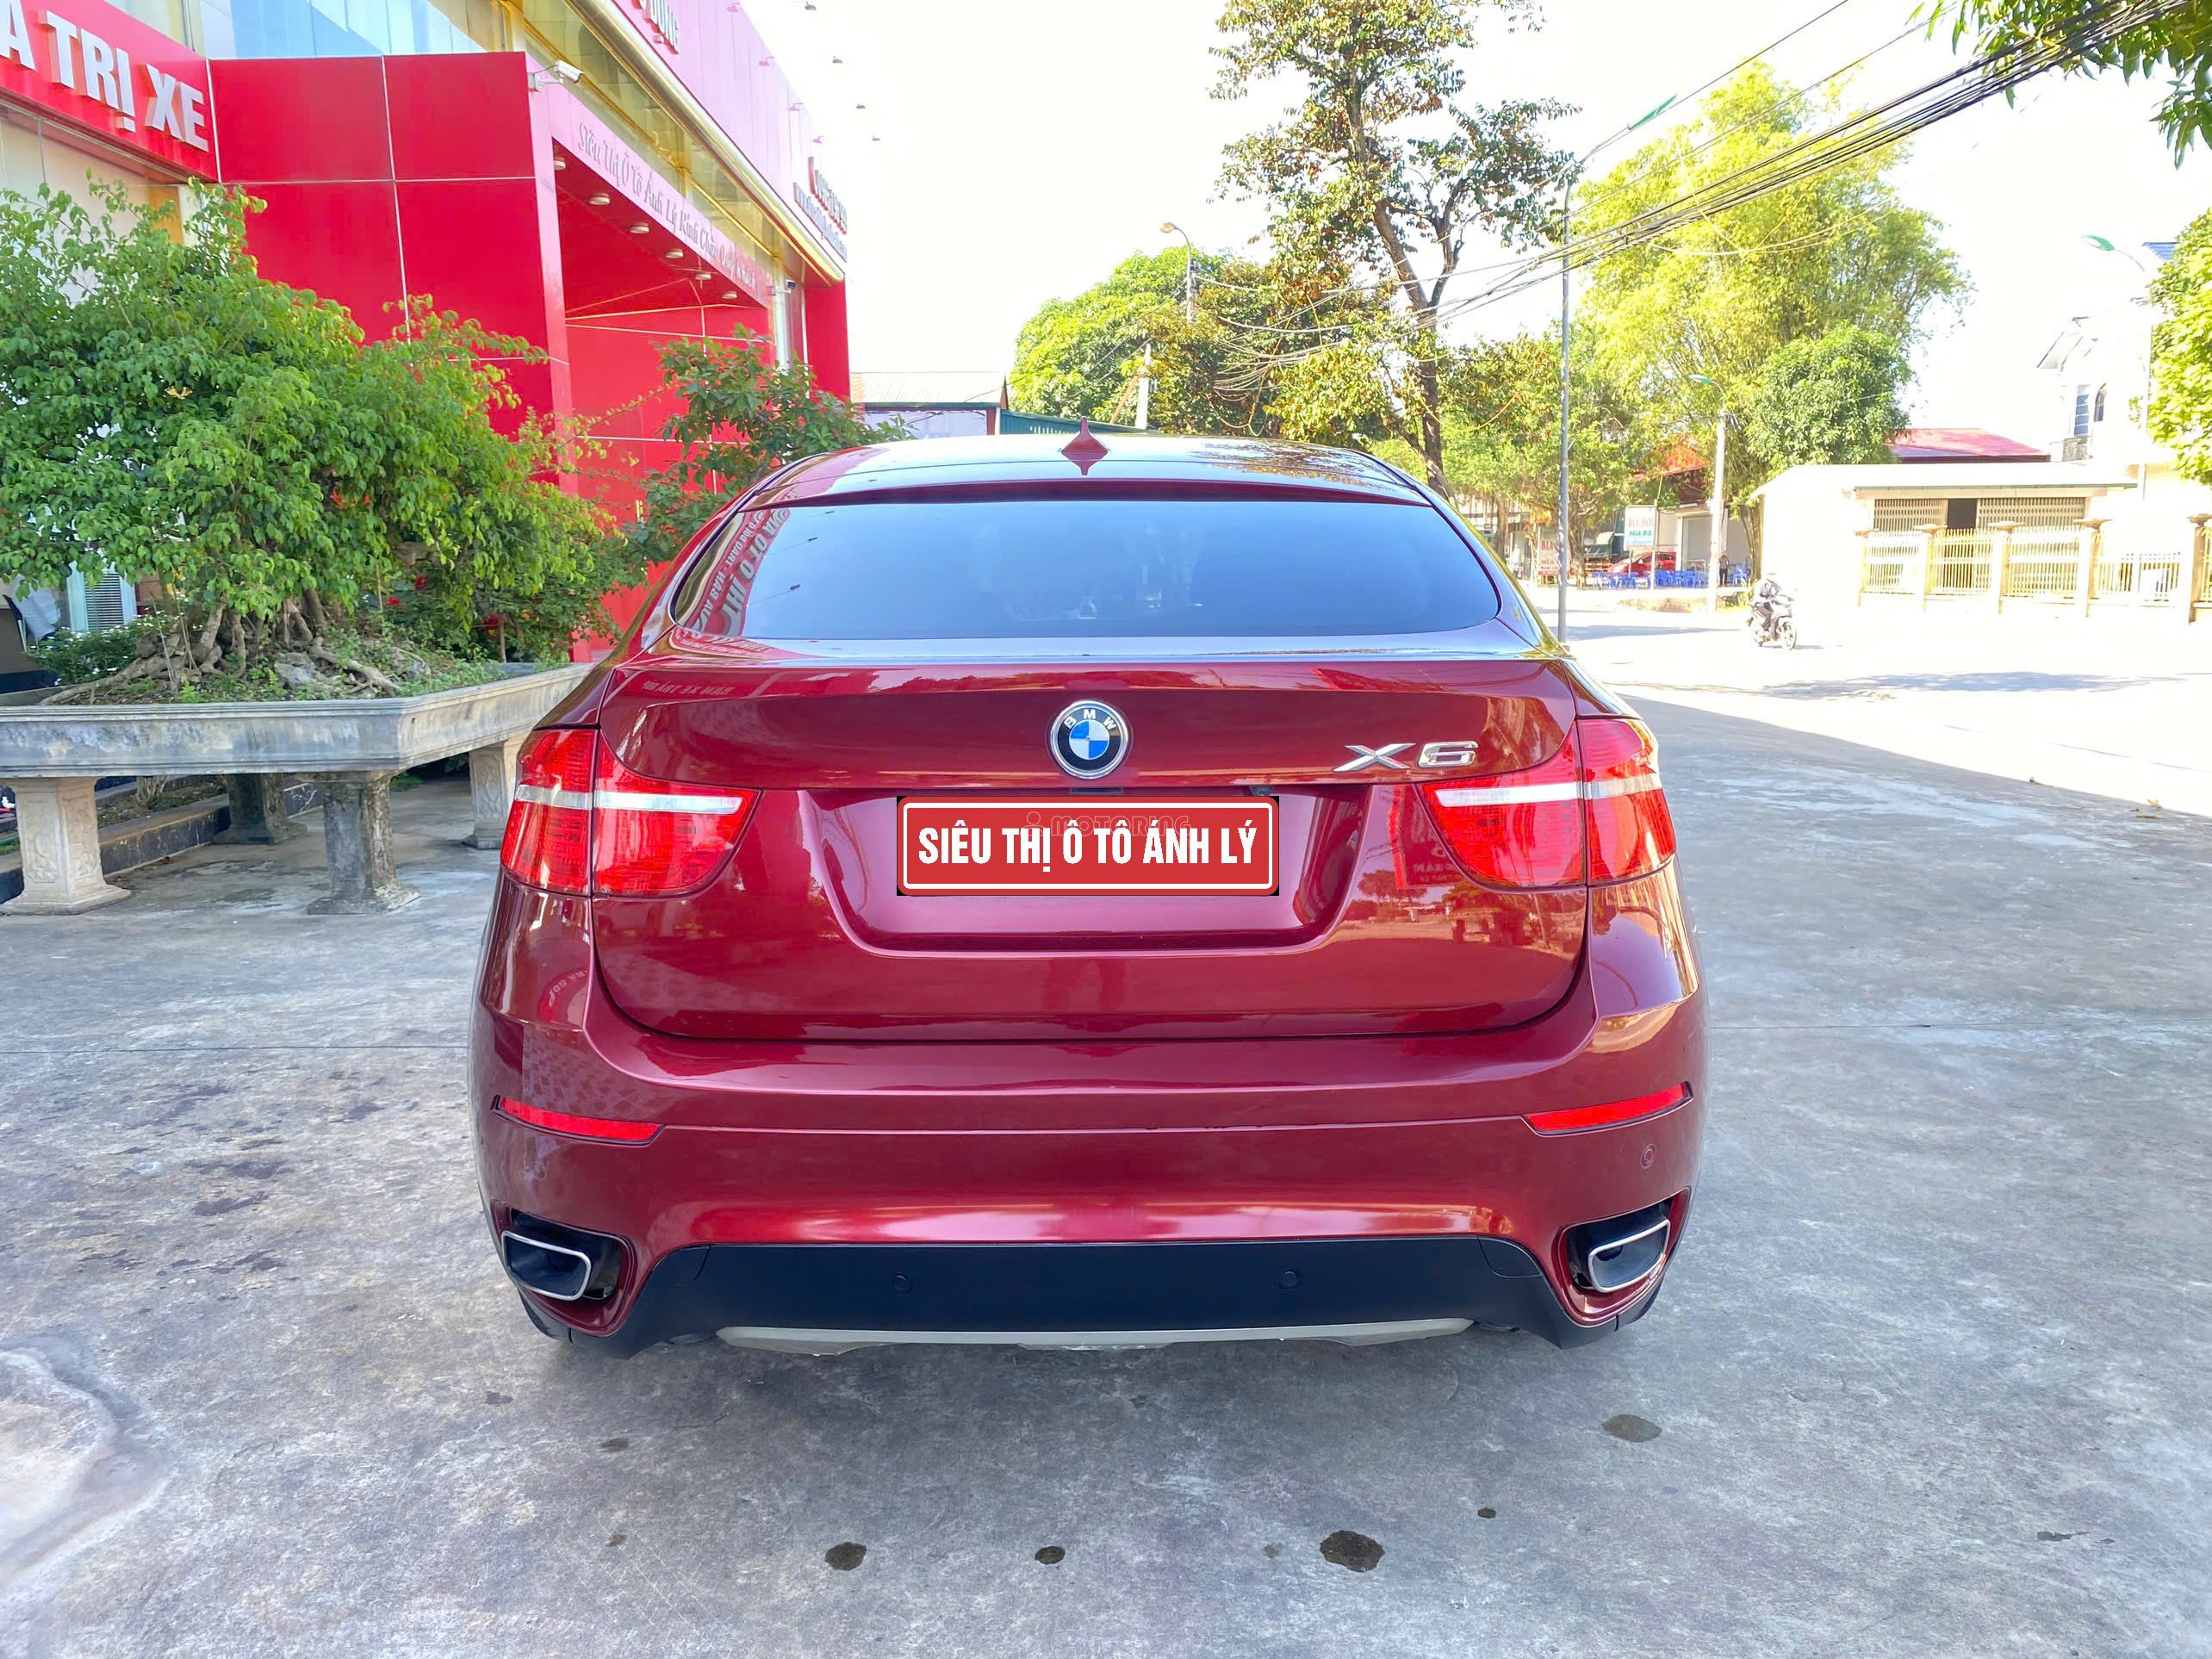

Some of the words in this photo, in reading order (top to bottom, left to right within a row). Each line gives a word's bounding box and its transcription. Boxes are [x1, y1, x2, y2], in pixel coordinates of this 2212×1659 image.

[46, 9, 136, 133] TRỊ
[146, 62, 209, 152] XE
[1063, 709, 1117, 730] BMW
[1333, 741, 1479, 772] X6
